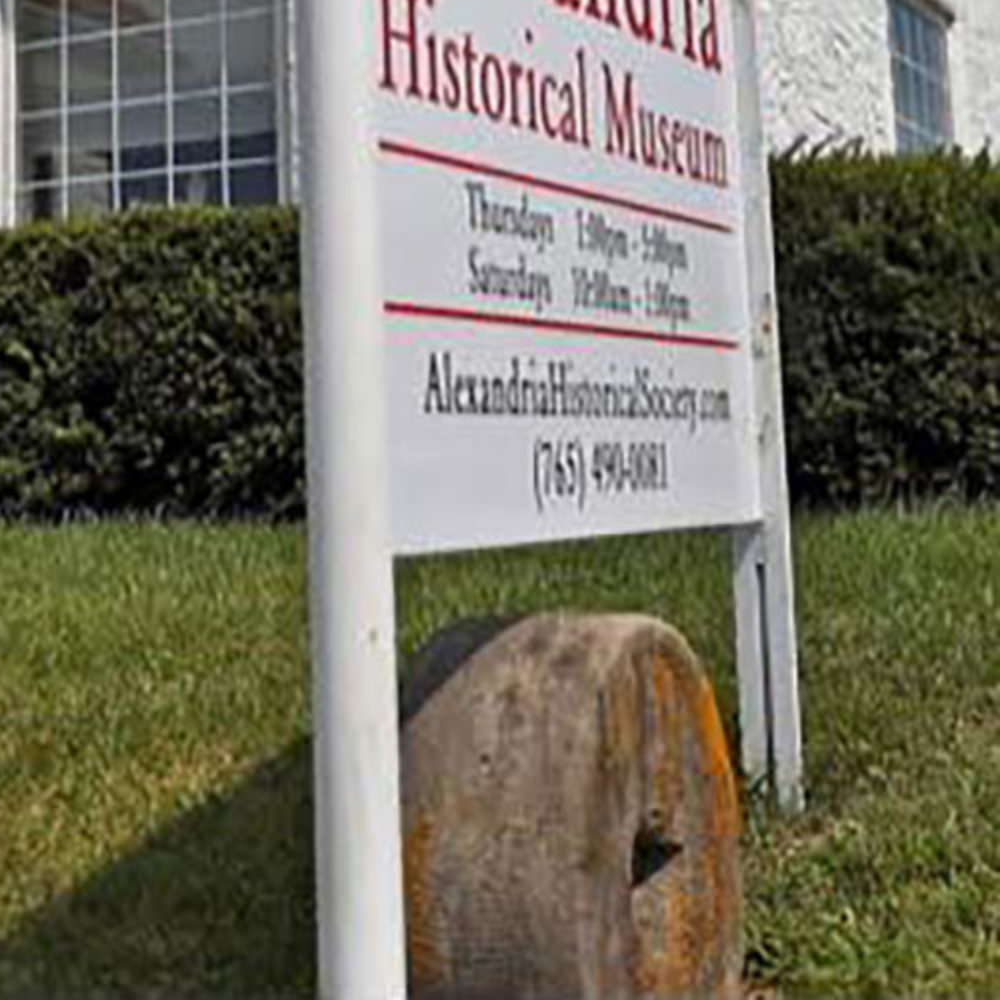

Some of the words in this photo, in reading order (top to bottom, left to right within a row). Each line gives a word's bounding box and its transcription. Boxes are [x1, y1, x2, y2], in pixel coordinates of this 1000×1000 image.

[602, 62, 729, 188] Museum
[465, 180, 555, 253] Thursdays
[467, 246, 553, 314] Saturdays
[533, 438, 586, 512] (765)
